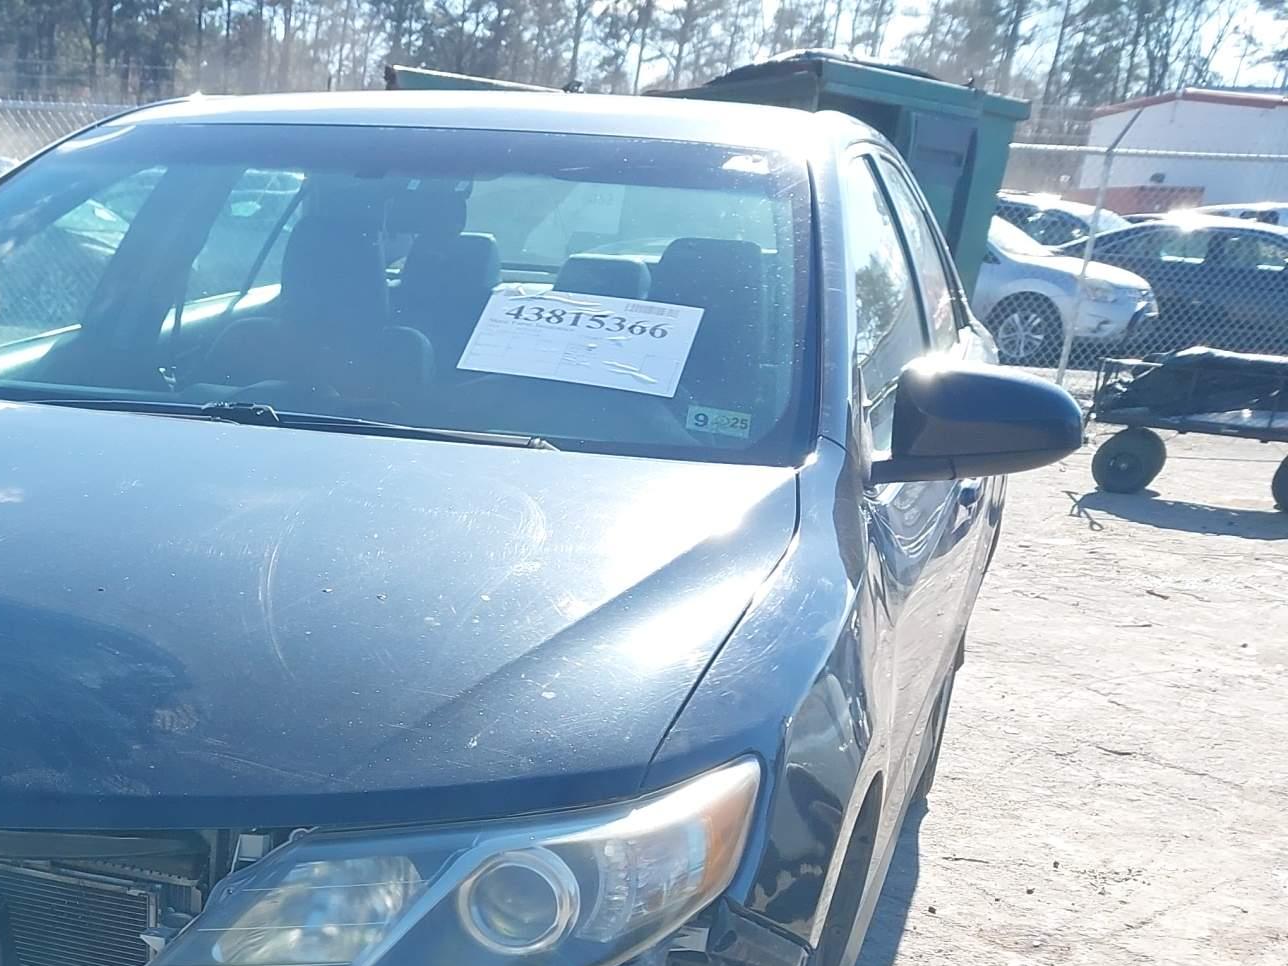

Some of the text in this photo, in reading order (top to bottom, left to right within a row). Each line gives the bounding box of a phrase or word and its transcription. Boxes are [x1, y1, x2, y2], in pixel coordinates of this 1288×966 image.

[505, 304, 669, 339] 43815366
[694, 412, 748, 430] 9 25
